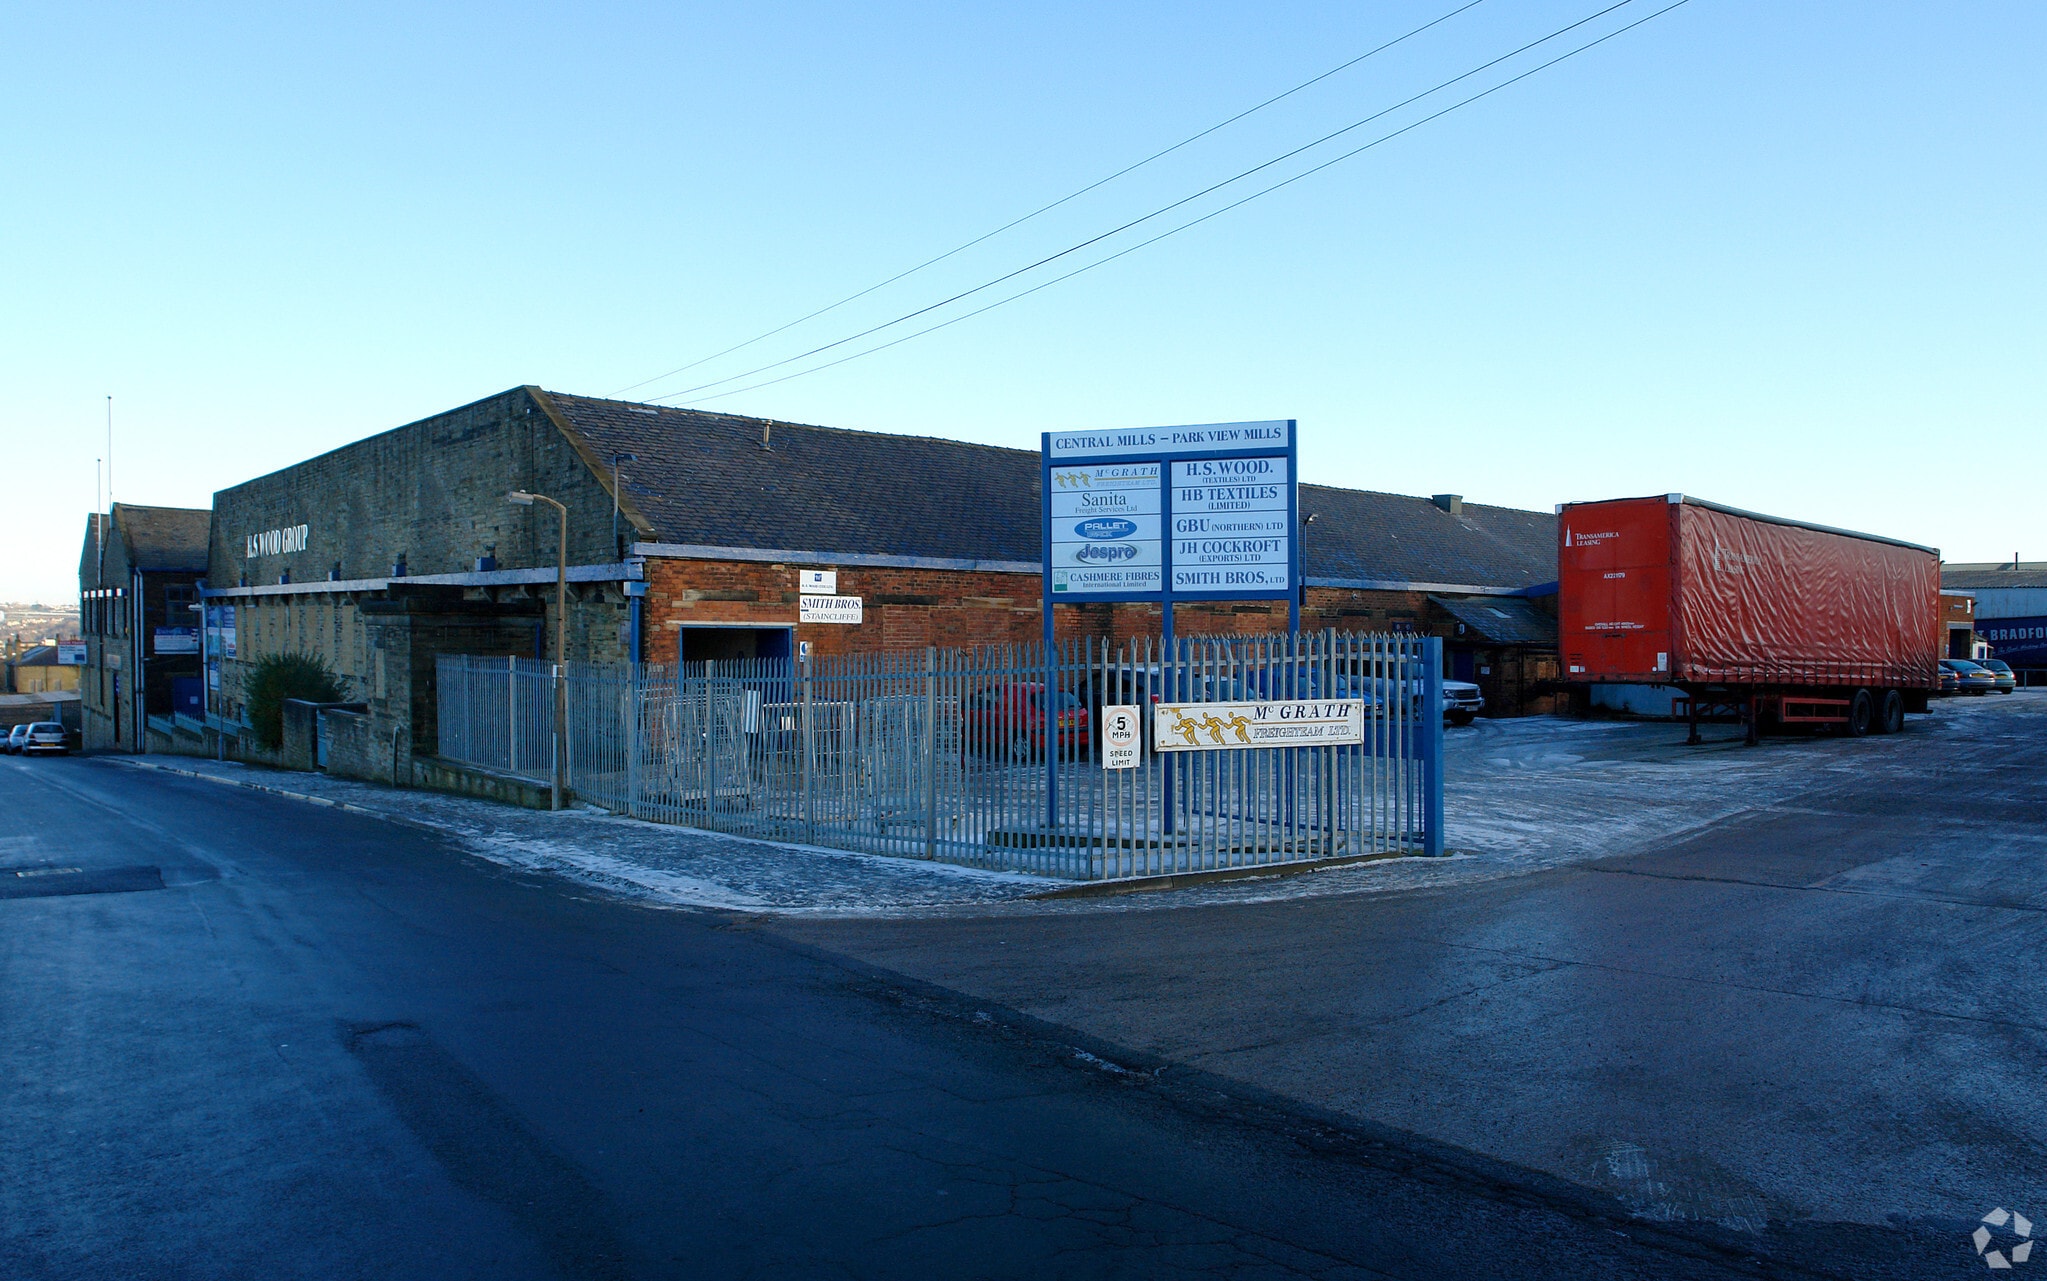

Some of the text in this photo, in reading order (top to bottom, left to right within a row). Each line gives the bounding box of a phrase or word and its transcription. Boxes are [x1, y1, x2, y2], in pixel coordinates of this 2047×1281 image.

[1056, 436, 1113, 449] CENTRAL
[1117, 434, 1156, 446] MILLS
[1172, 431, 1205, 443] PARK
[1208, 429, 1241, 441] VIEW
[1244, 427, 1281, 440] MILLS
[1202, 476, 1240, 484] (TEXTILES)
[1081, 491, 1127, 507] Sanita
[1181, 486, 1278, 501] HB TEXTILES
[1075, 506, 1097, 515] Freight
[1208, 501, 1250, 510] (LIMITED)
[1085, 521, 1128, 531] PALLET
[1176, 519, 1283, 533] GBU (NORTHERN) LTD
[259, 529, 281, 557] WOOD
[282, 524, 308, 554] GROUP
[1180, 540, 1281, 554] JH COCKROFT
[1080, 543, 1135, 562] Jespro
[1199, 554, 1261, 563] (EXPORTS) LTD
[1070, 571, 1160, 582] CASHMERE FIBRES
[1175, 571, 1220, 585] SMITH
[1269, 576, 1285, 584] LTD
[801, 598, 861, 610] SMITH BROS.
[803, 612, 859, 621] (STAINCLIFFE)
[1990, 626, 2047, 641] BRADFO
[1116, 716, 1126, 731] 5
[1112, 731, 1131, 739] MPH
